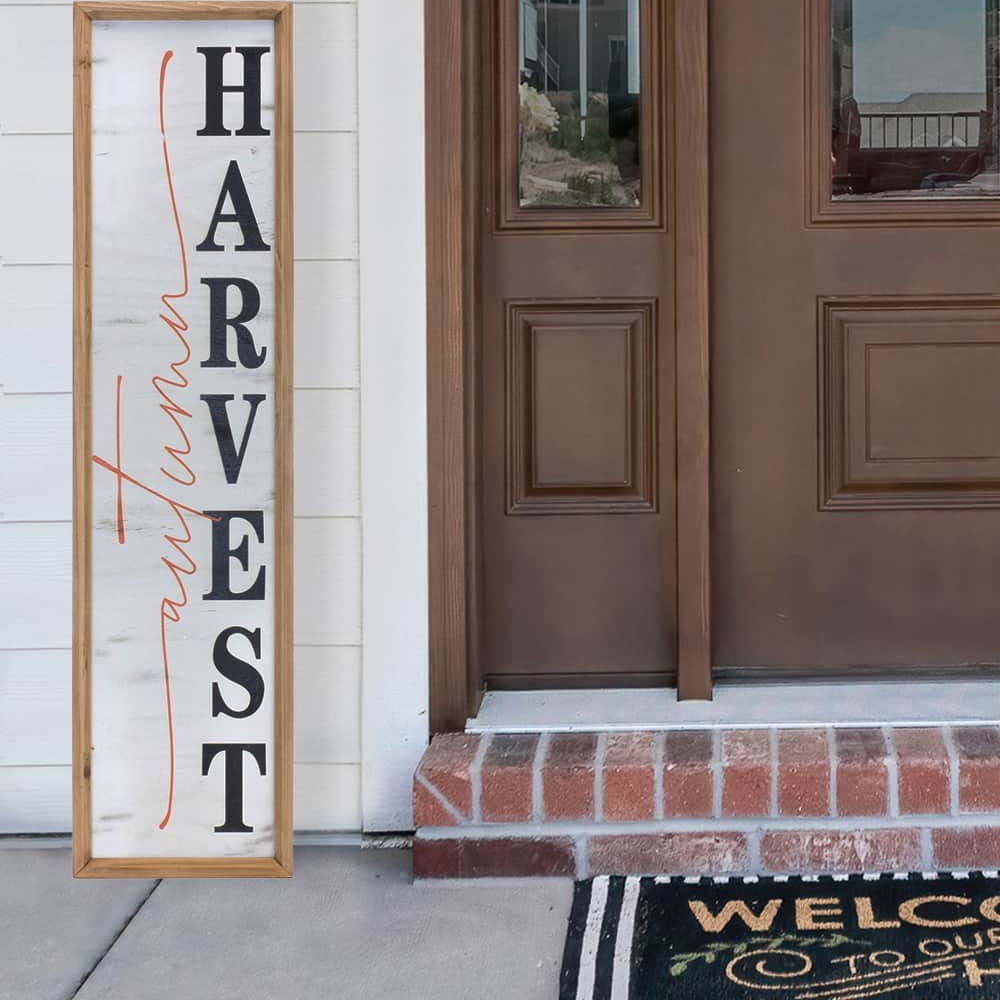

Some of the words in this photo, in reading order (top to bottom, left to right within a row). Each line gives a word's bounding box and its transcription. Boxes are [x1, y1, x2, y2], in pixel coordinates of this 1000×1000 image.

[92, 50, 222, 831] autumn
[196, 46, 271, 833] HARVEST
[830, 949, 906, 975] TO
